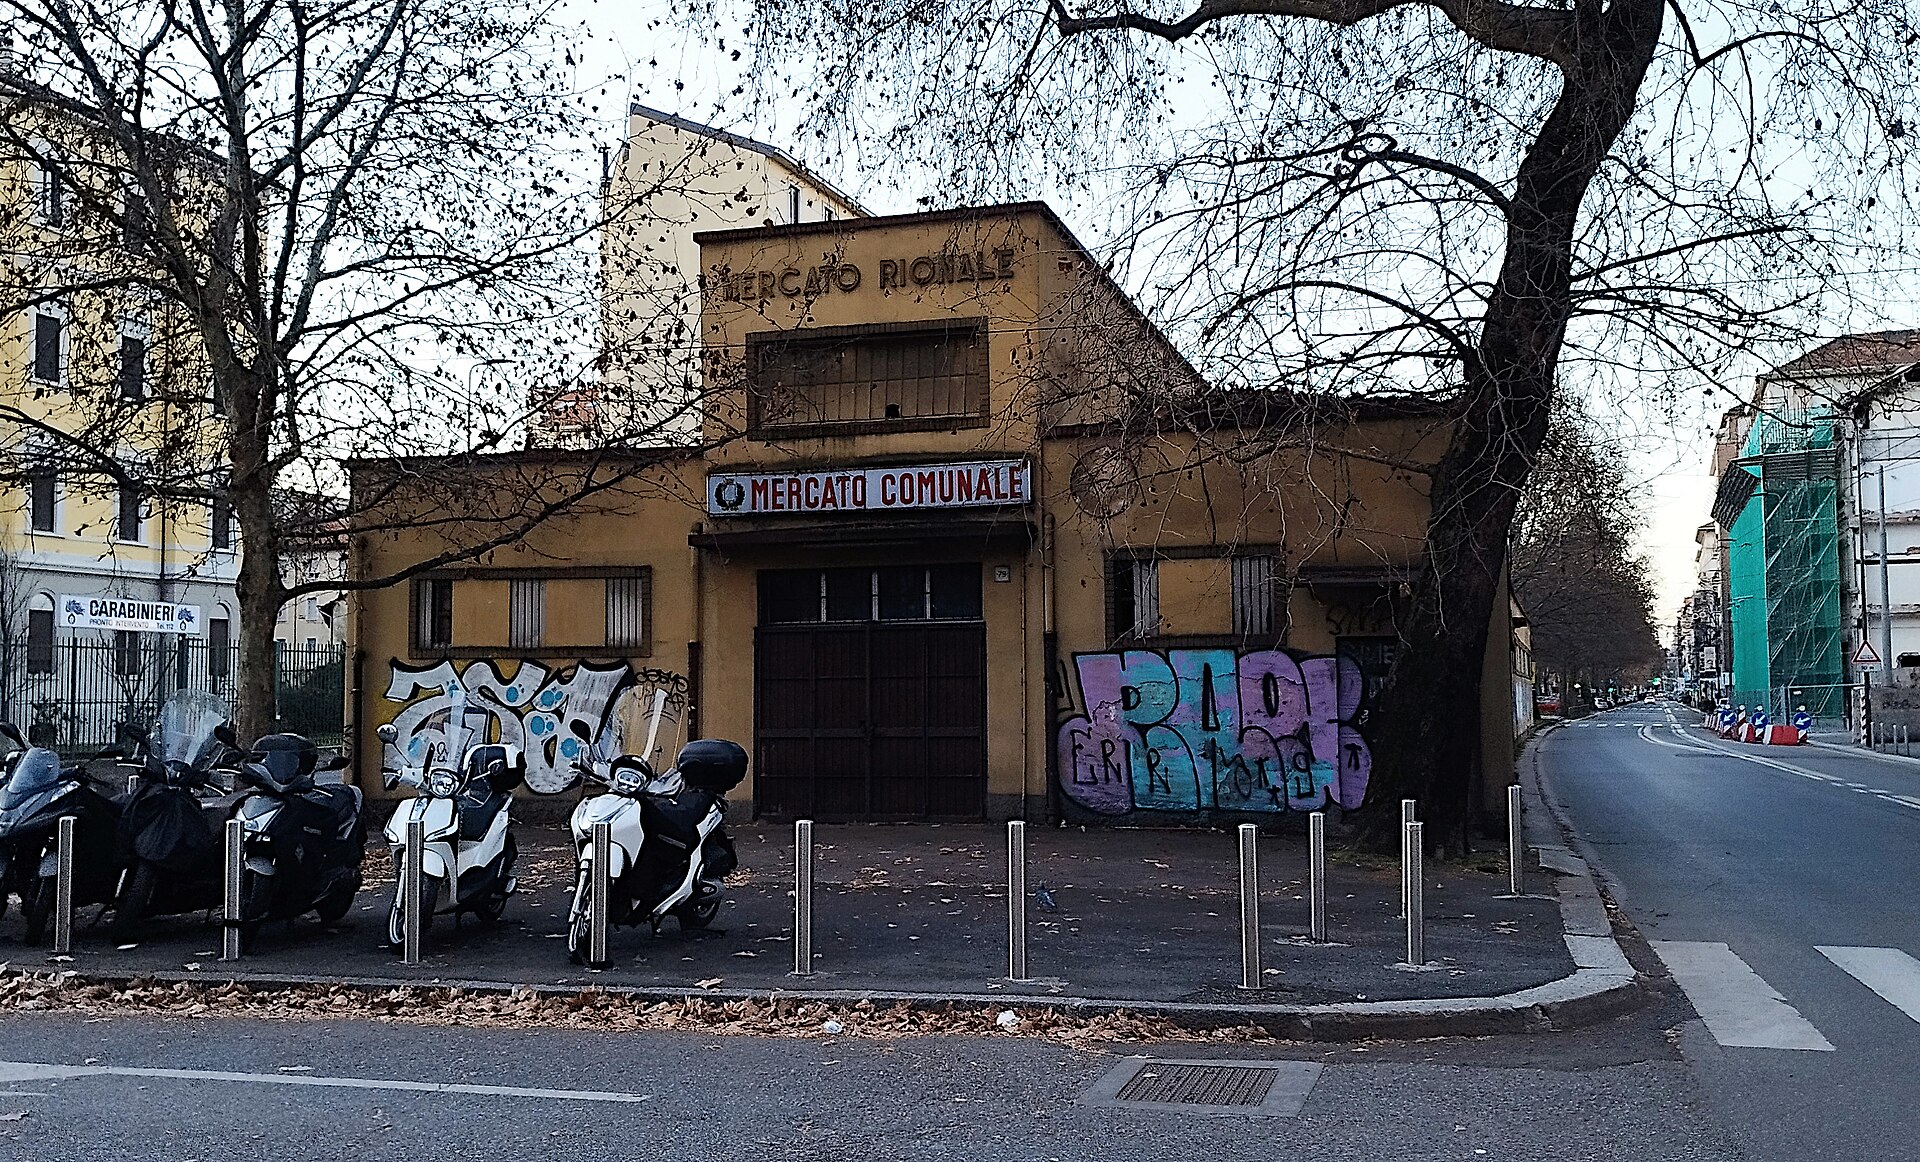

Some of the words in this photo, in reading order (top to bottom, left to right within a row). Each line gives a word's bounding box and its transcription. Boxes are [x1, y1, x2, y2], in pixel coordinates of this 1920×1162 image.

[722, 263, 861, 301] MERCATO
[880, 248, 1014, 289] RIONALE
[751, 474, 865, 510] MERCATO
[880, 464, 1022, 506] COMUNALE
[89, 600, 174, 621] CARABINIERI
[89, 618, 113, 627] PRONTO
